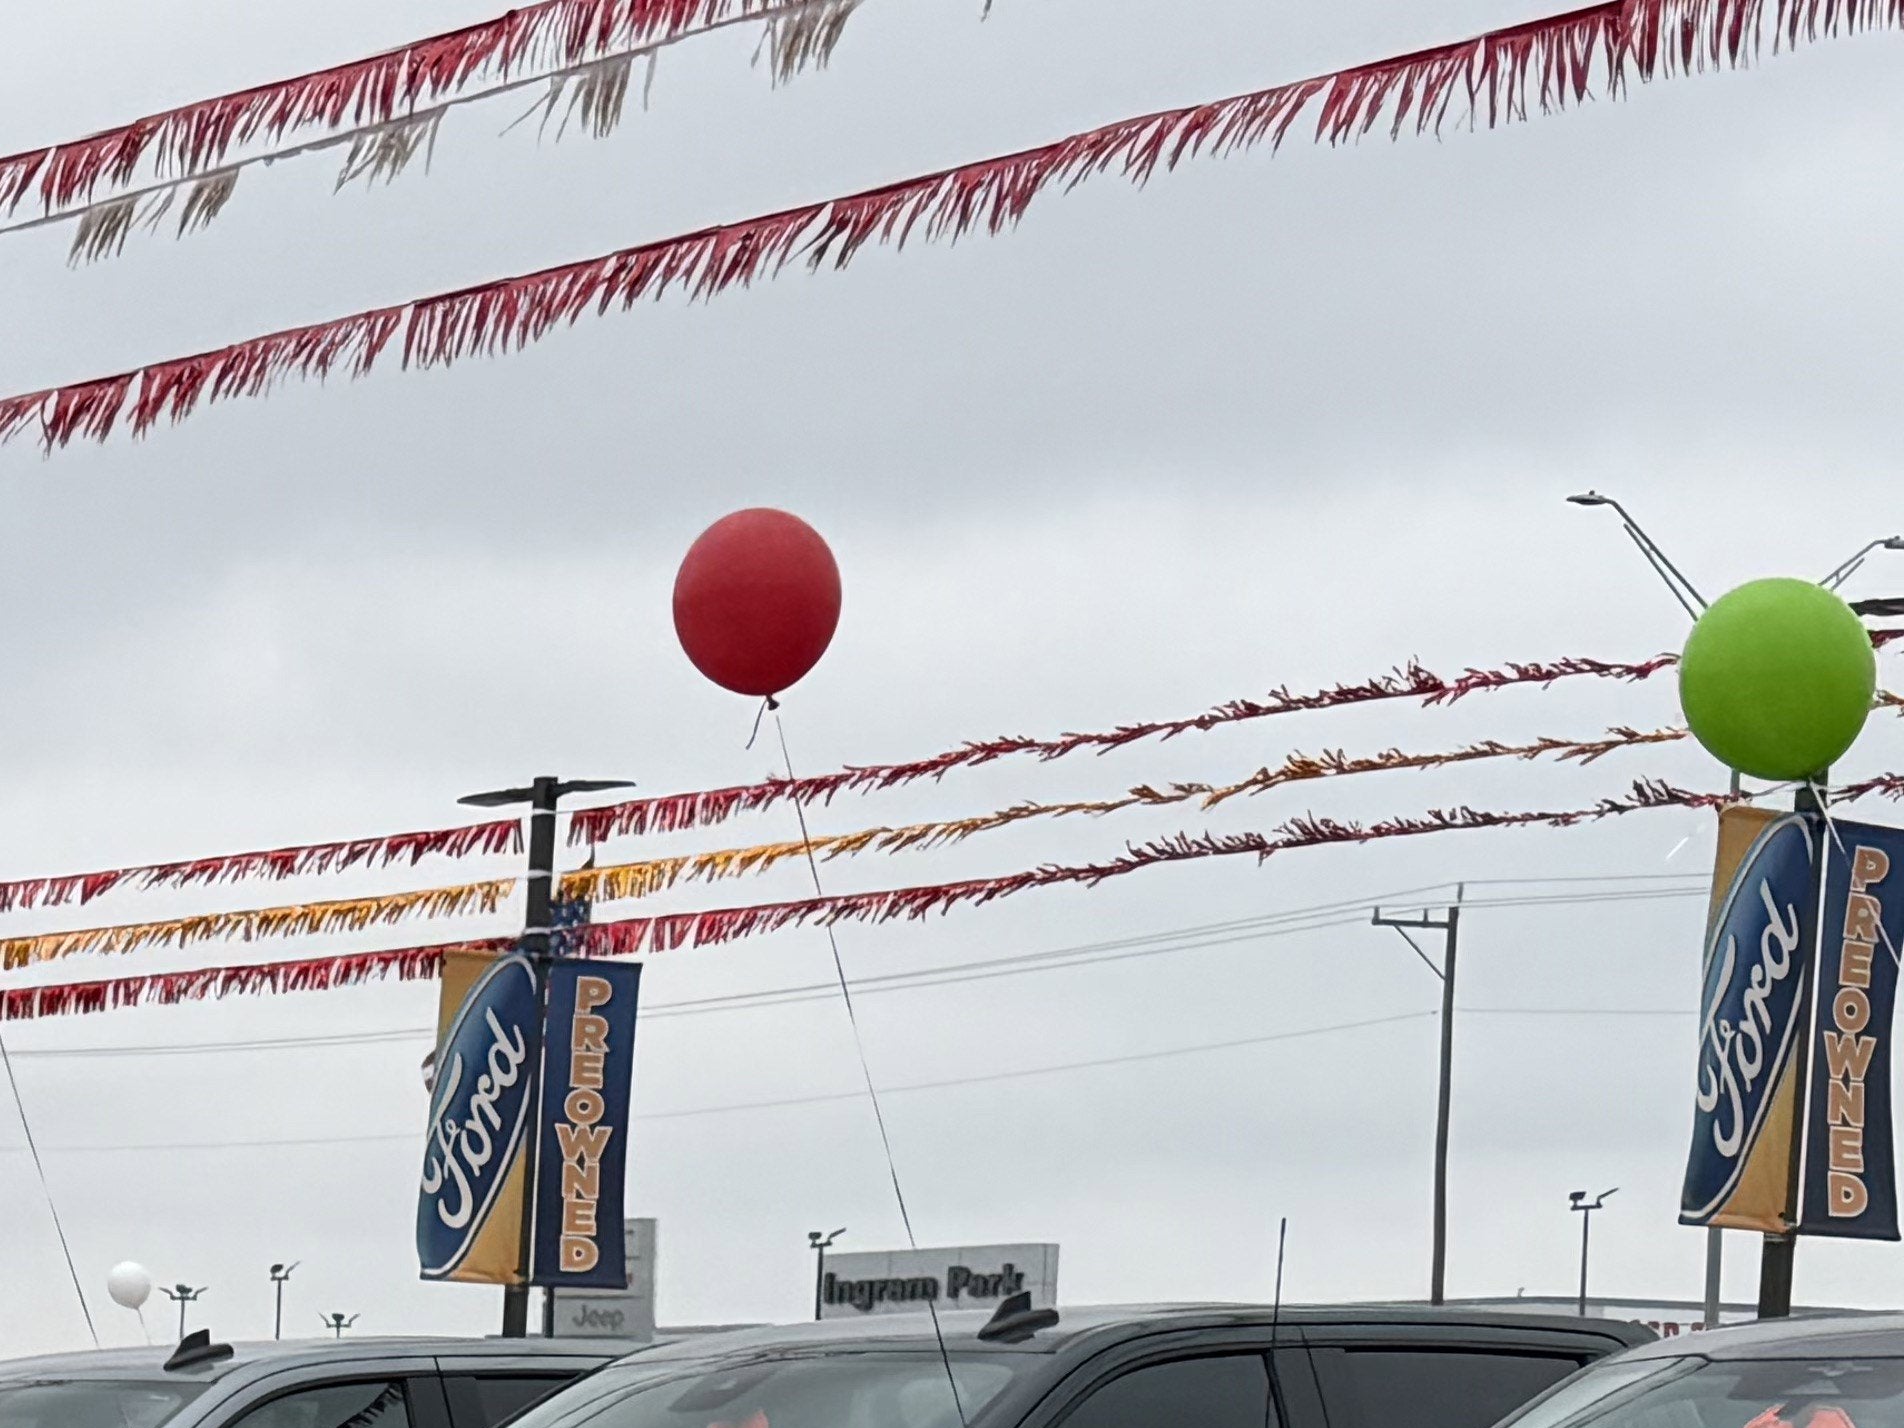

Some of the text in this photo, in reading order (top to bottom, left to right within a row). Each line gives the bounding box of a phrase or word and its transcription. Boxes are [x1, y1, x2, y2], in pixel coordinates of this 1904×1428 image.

[422, 1006, 526, 1229] Ford
[554, 975, 613, 1273] PREOWNED
[1697, 878, 1799, 1157] Ford
[1823, 845, 1890, 1218] PREOWNED
[571, 1304, 625, 1330] Jeep
[823, 1262, 1025, 1313] Ingram Park
